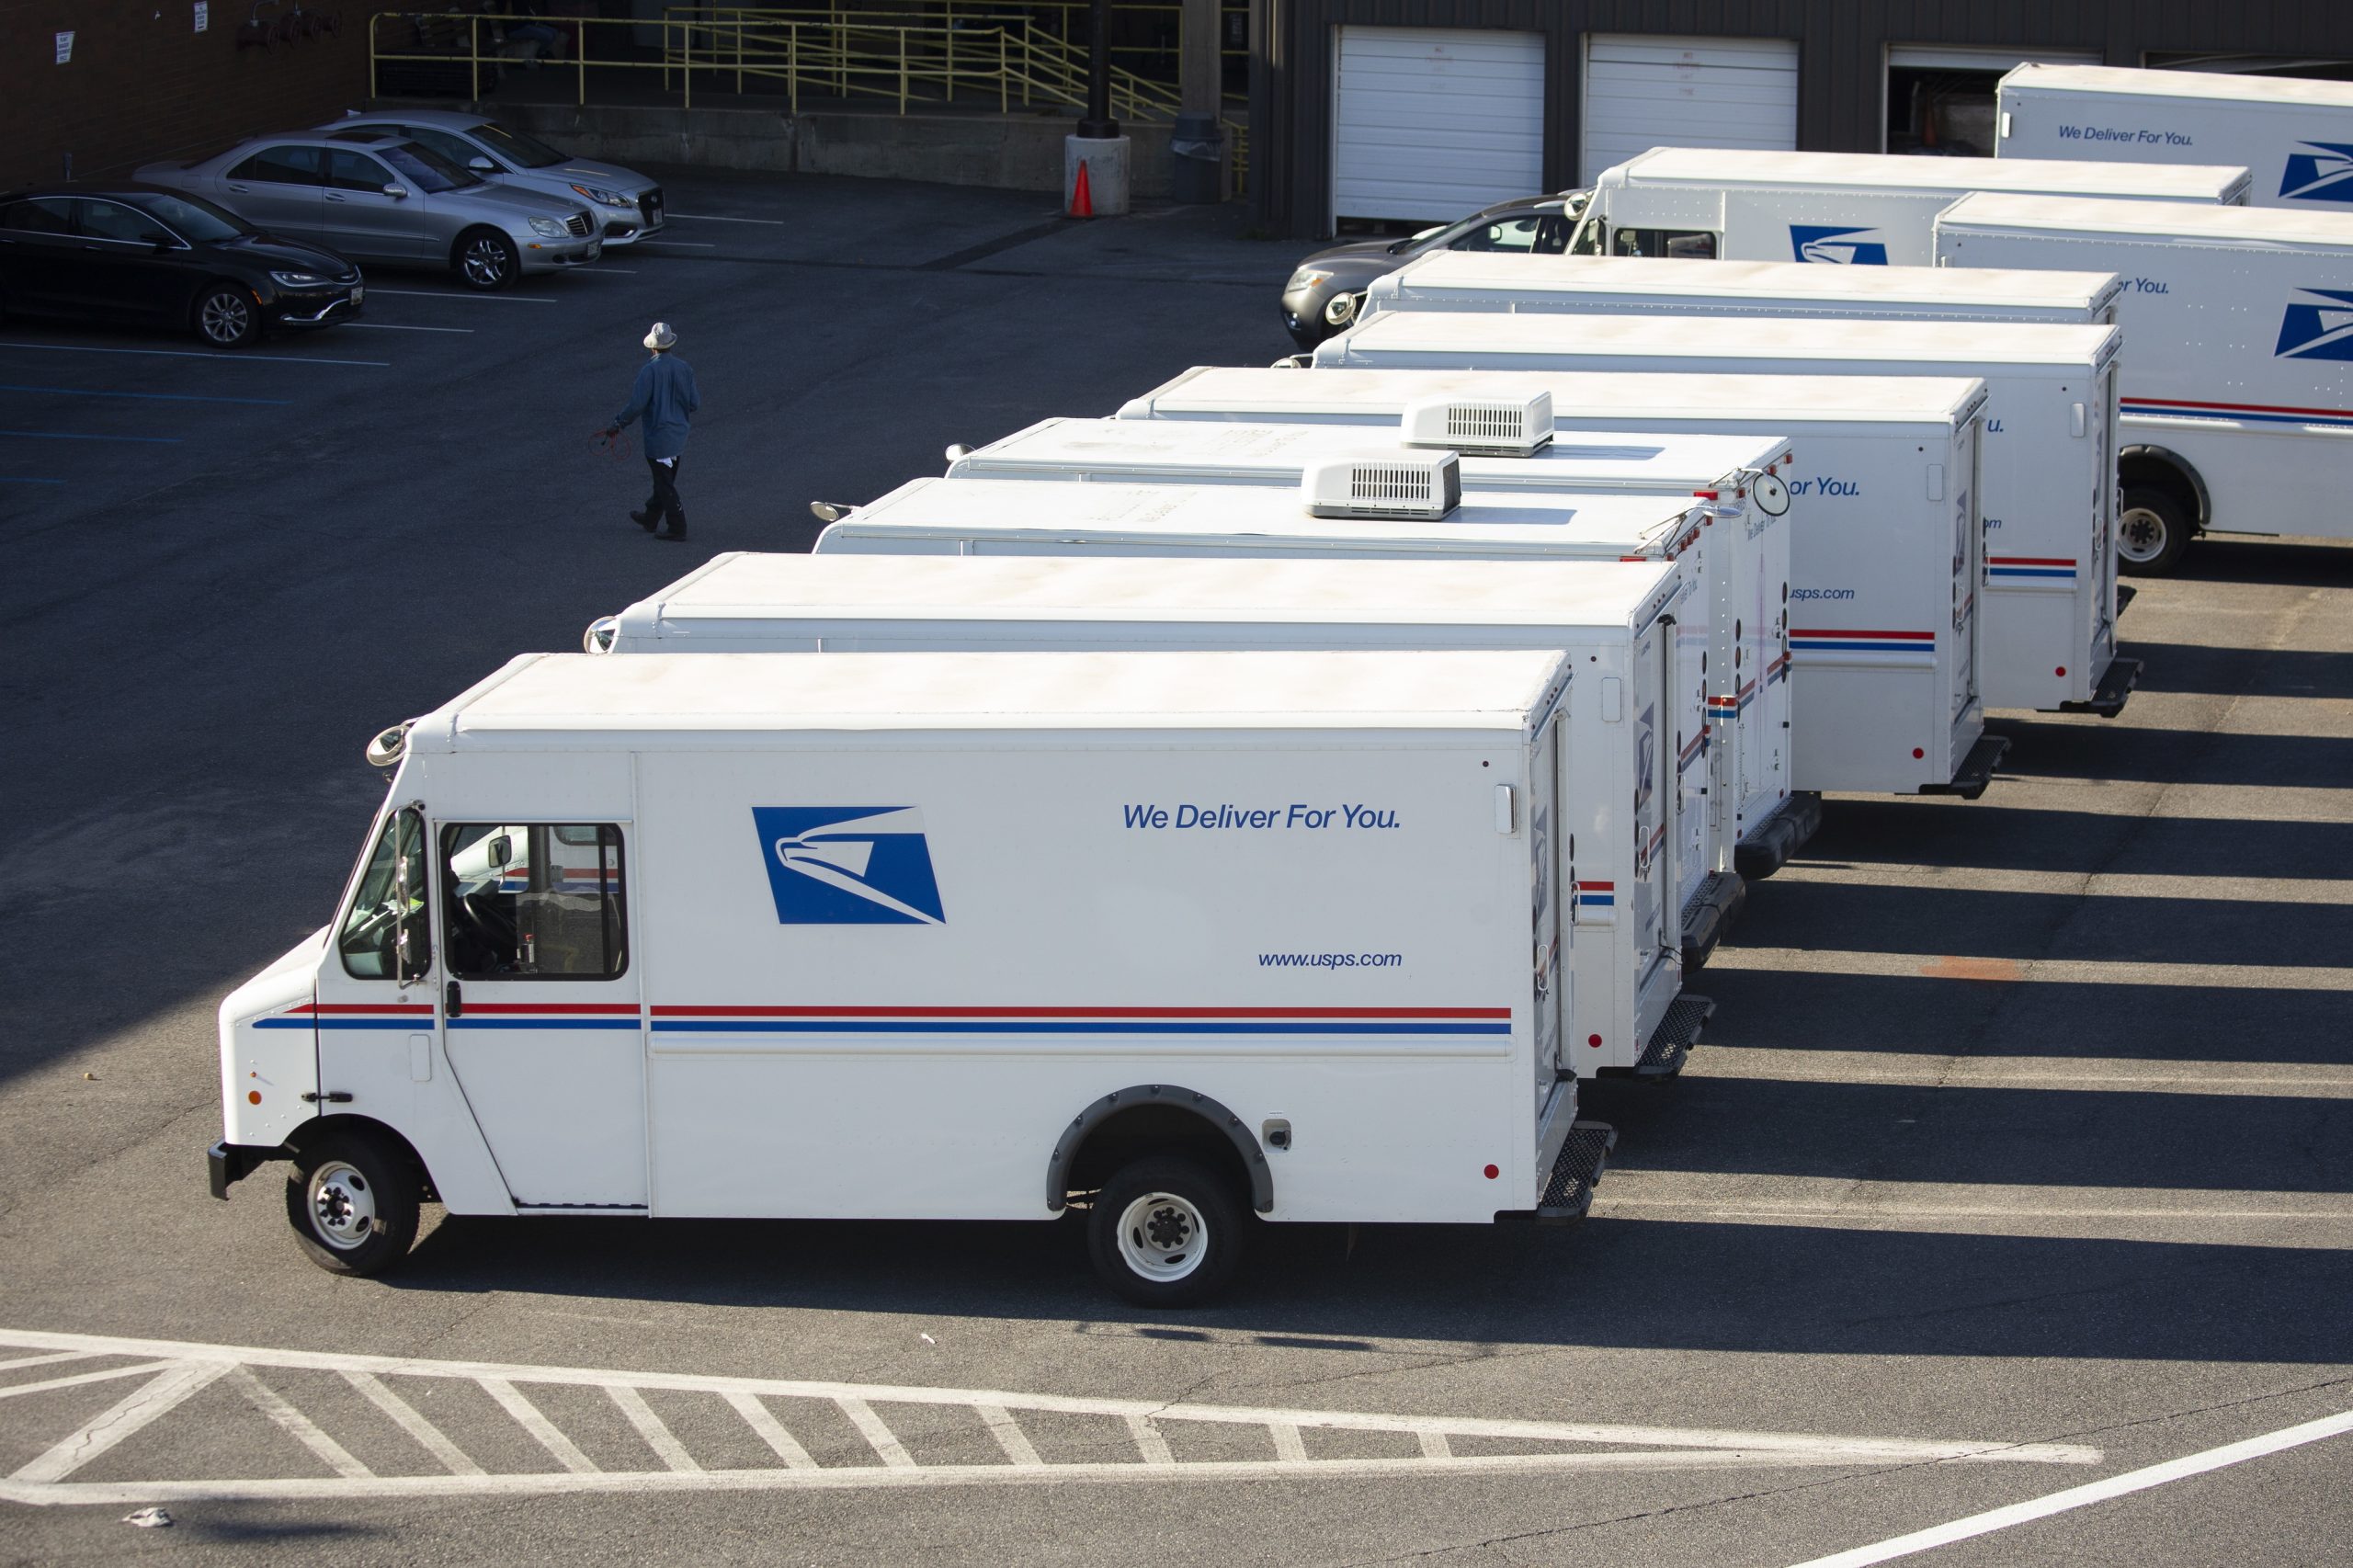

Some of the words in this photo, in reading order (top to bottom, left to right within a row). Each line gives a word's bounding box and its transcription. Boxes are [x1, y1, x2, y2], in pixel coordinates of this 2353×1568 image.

[2059, 125, 2081, 139] We
[2084, 127, 2135, 142] Deliver
[2137, 130, 2162, 143] For
[2165, 131, 2193, 146] You.
[2135, 278, 2169, 294] You.
[1790, 481, 1813, 495] or
[1816, 477, 1860, 496] You.
[1789, 588, 1855, 601] sps.com
[1123, 804, 1169, 829] We
[1176, 804, 1280, 829] Deliver
[1286, 804, 1336, 829] For
[1342, 804, 1401, 829] You.
[1258, 953, 1403, 971] www.usps.com
